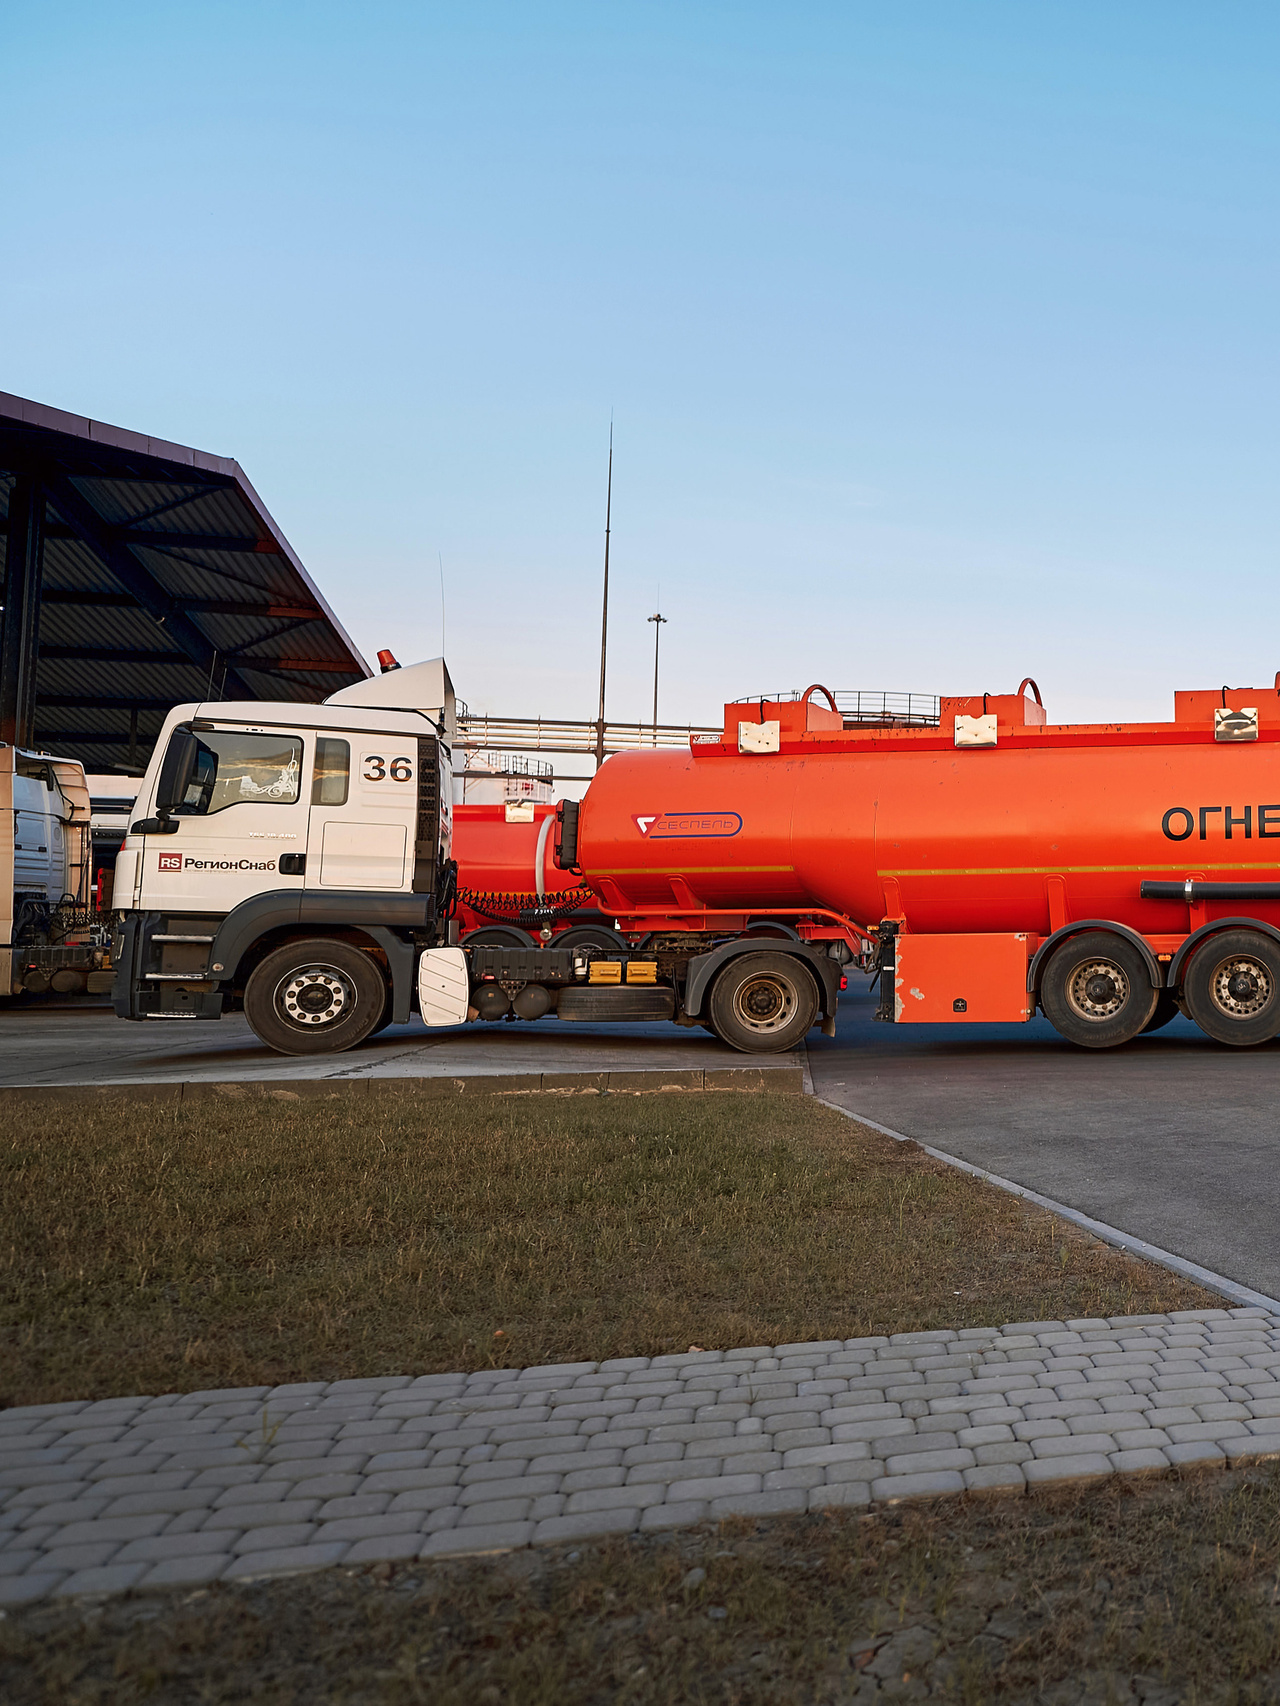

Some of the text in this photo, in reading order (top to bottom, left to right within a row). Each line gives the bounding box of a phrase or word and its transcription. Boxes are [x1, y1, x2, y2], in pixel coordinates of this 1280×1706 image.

[363, 755, 413, 783] 36
[656, 819, 734, 831] СЕСПЕЛЬ
[160, 857, 181, 869] RS
[184, 858, 276, 871] РегионСнаб
